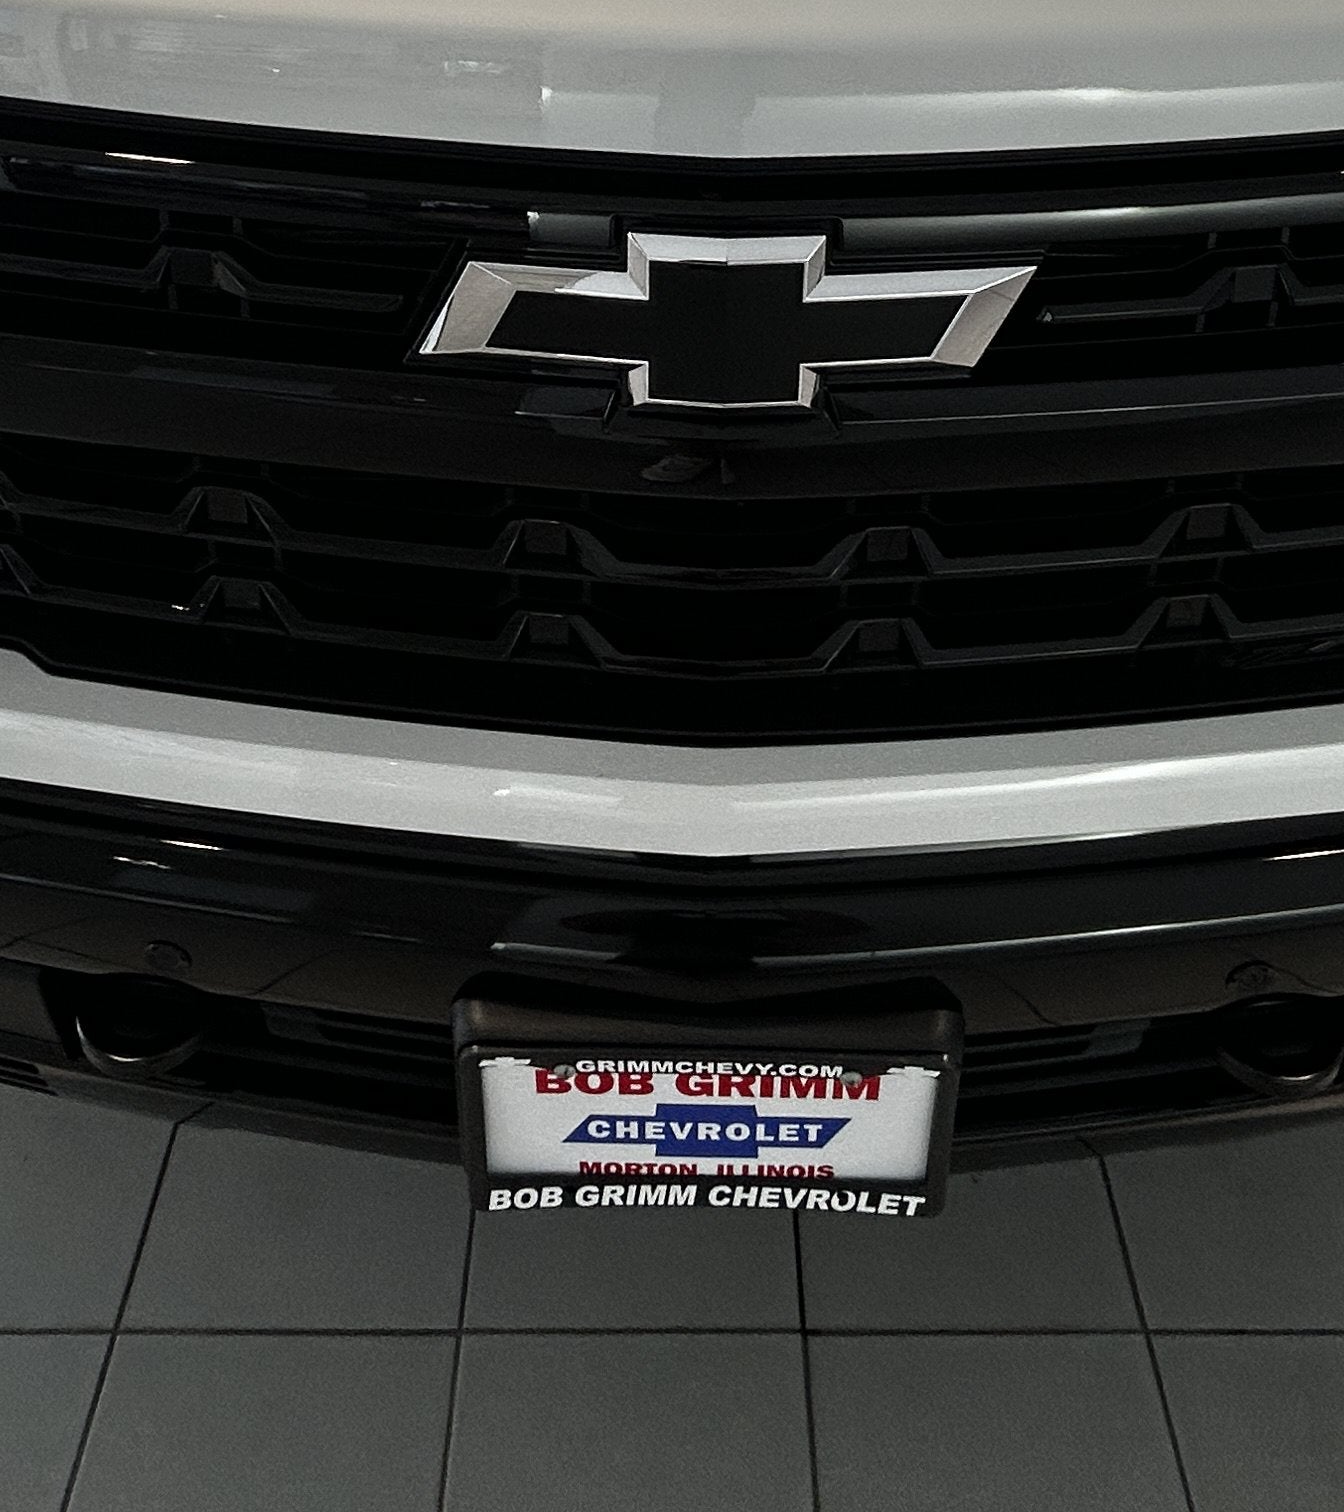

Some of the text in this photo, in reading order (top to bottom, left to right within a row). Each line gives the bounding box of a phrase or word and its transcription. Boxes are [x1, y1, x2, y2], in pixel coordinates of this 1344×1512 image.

[575, 1059, 844, 1078] GRIMMCHEVY.COM
[535, 1069, 882, 1101] BOB GRIMM
[587, 1120, 824, 1142] CHEVROLET
[579, 1161, 698, 1177] MORTON
[488, 1184, 927, 1217] BOB GRIMM CHEVROLET
